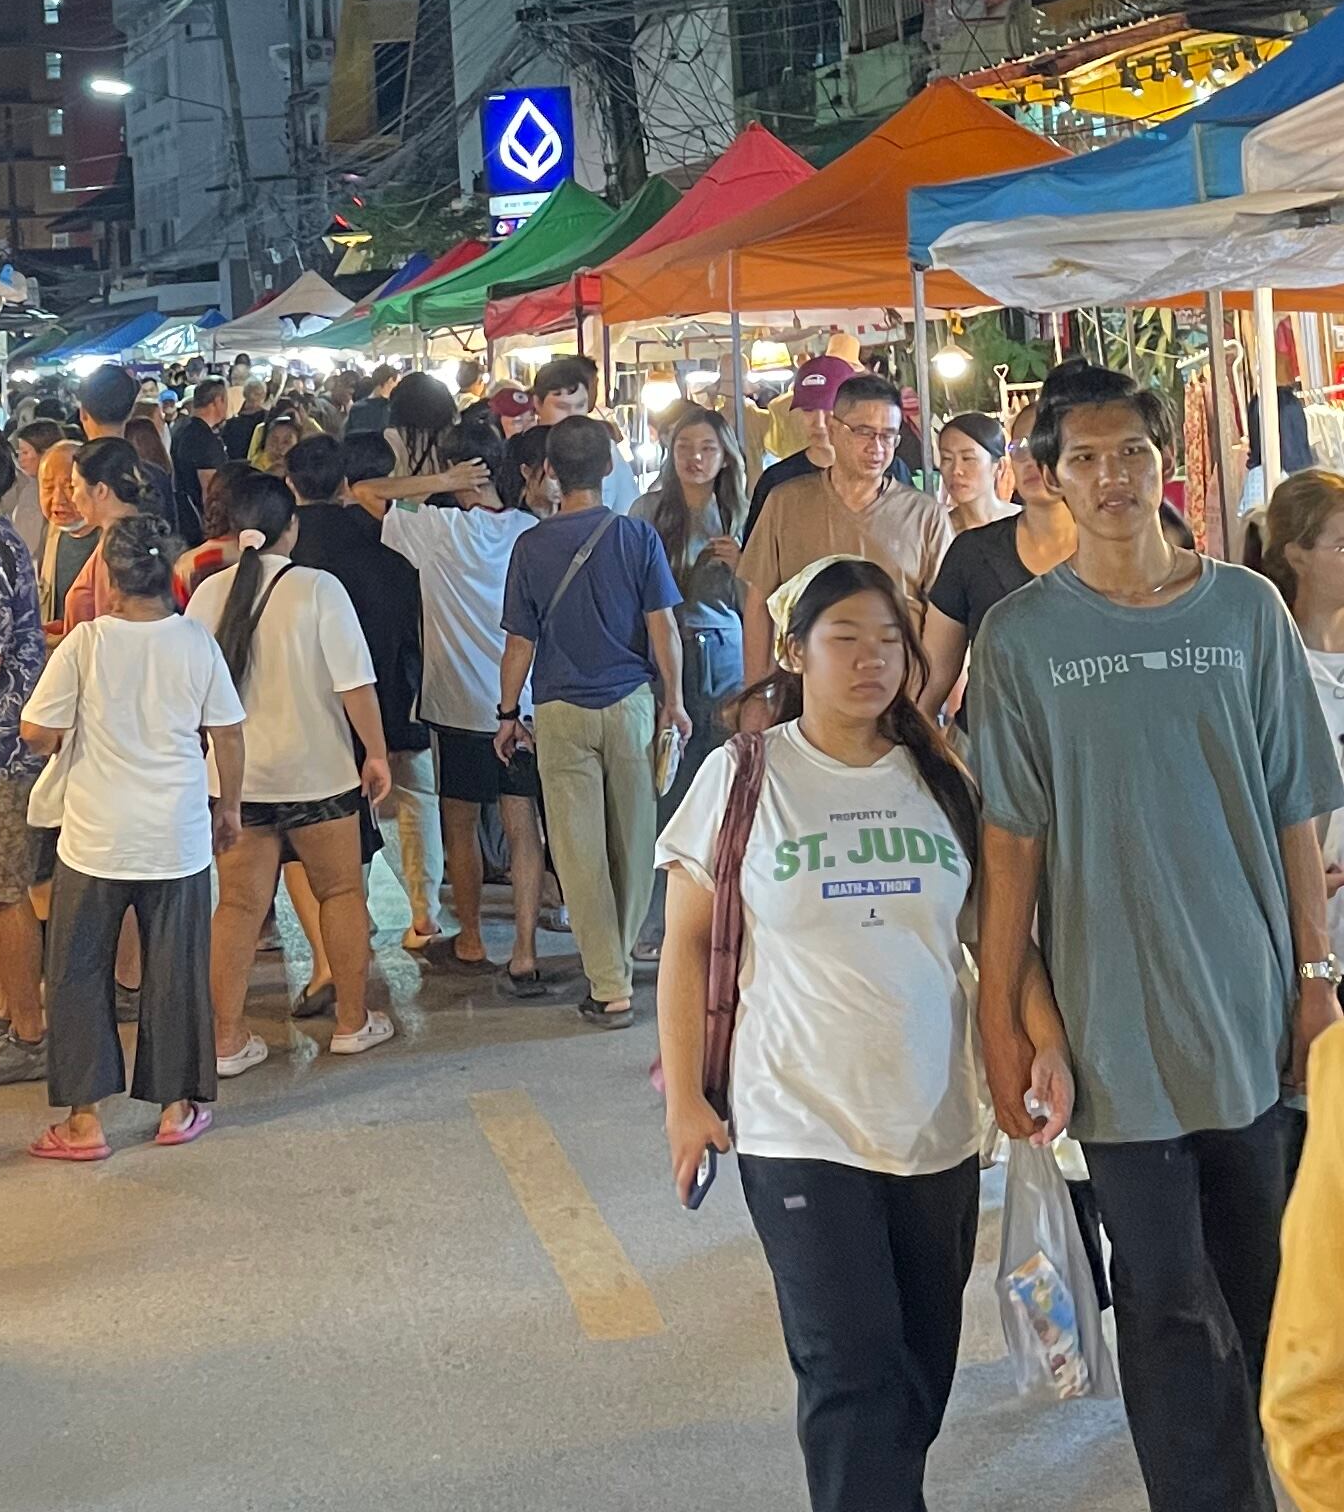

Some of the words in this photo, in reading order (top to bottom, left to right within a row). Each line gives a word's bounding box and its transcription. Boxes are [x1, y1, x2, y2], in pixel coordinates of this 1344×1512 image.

[1048, 653, 1130, 688] kappa
[1170, 638, 1246, 674] sigma
[829, 810, 882, 822] PROPERTY
[885, 809, 897, 819] OF
[773, 831, 836, 882] ST.
[847, 827, 961, 877] JUDE
